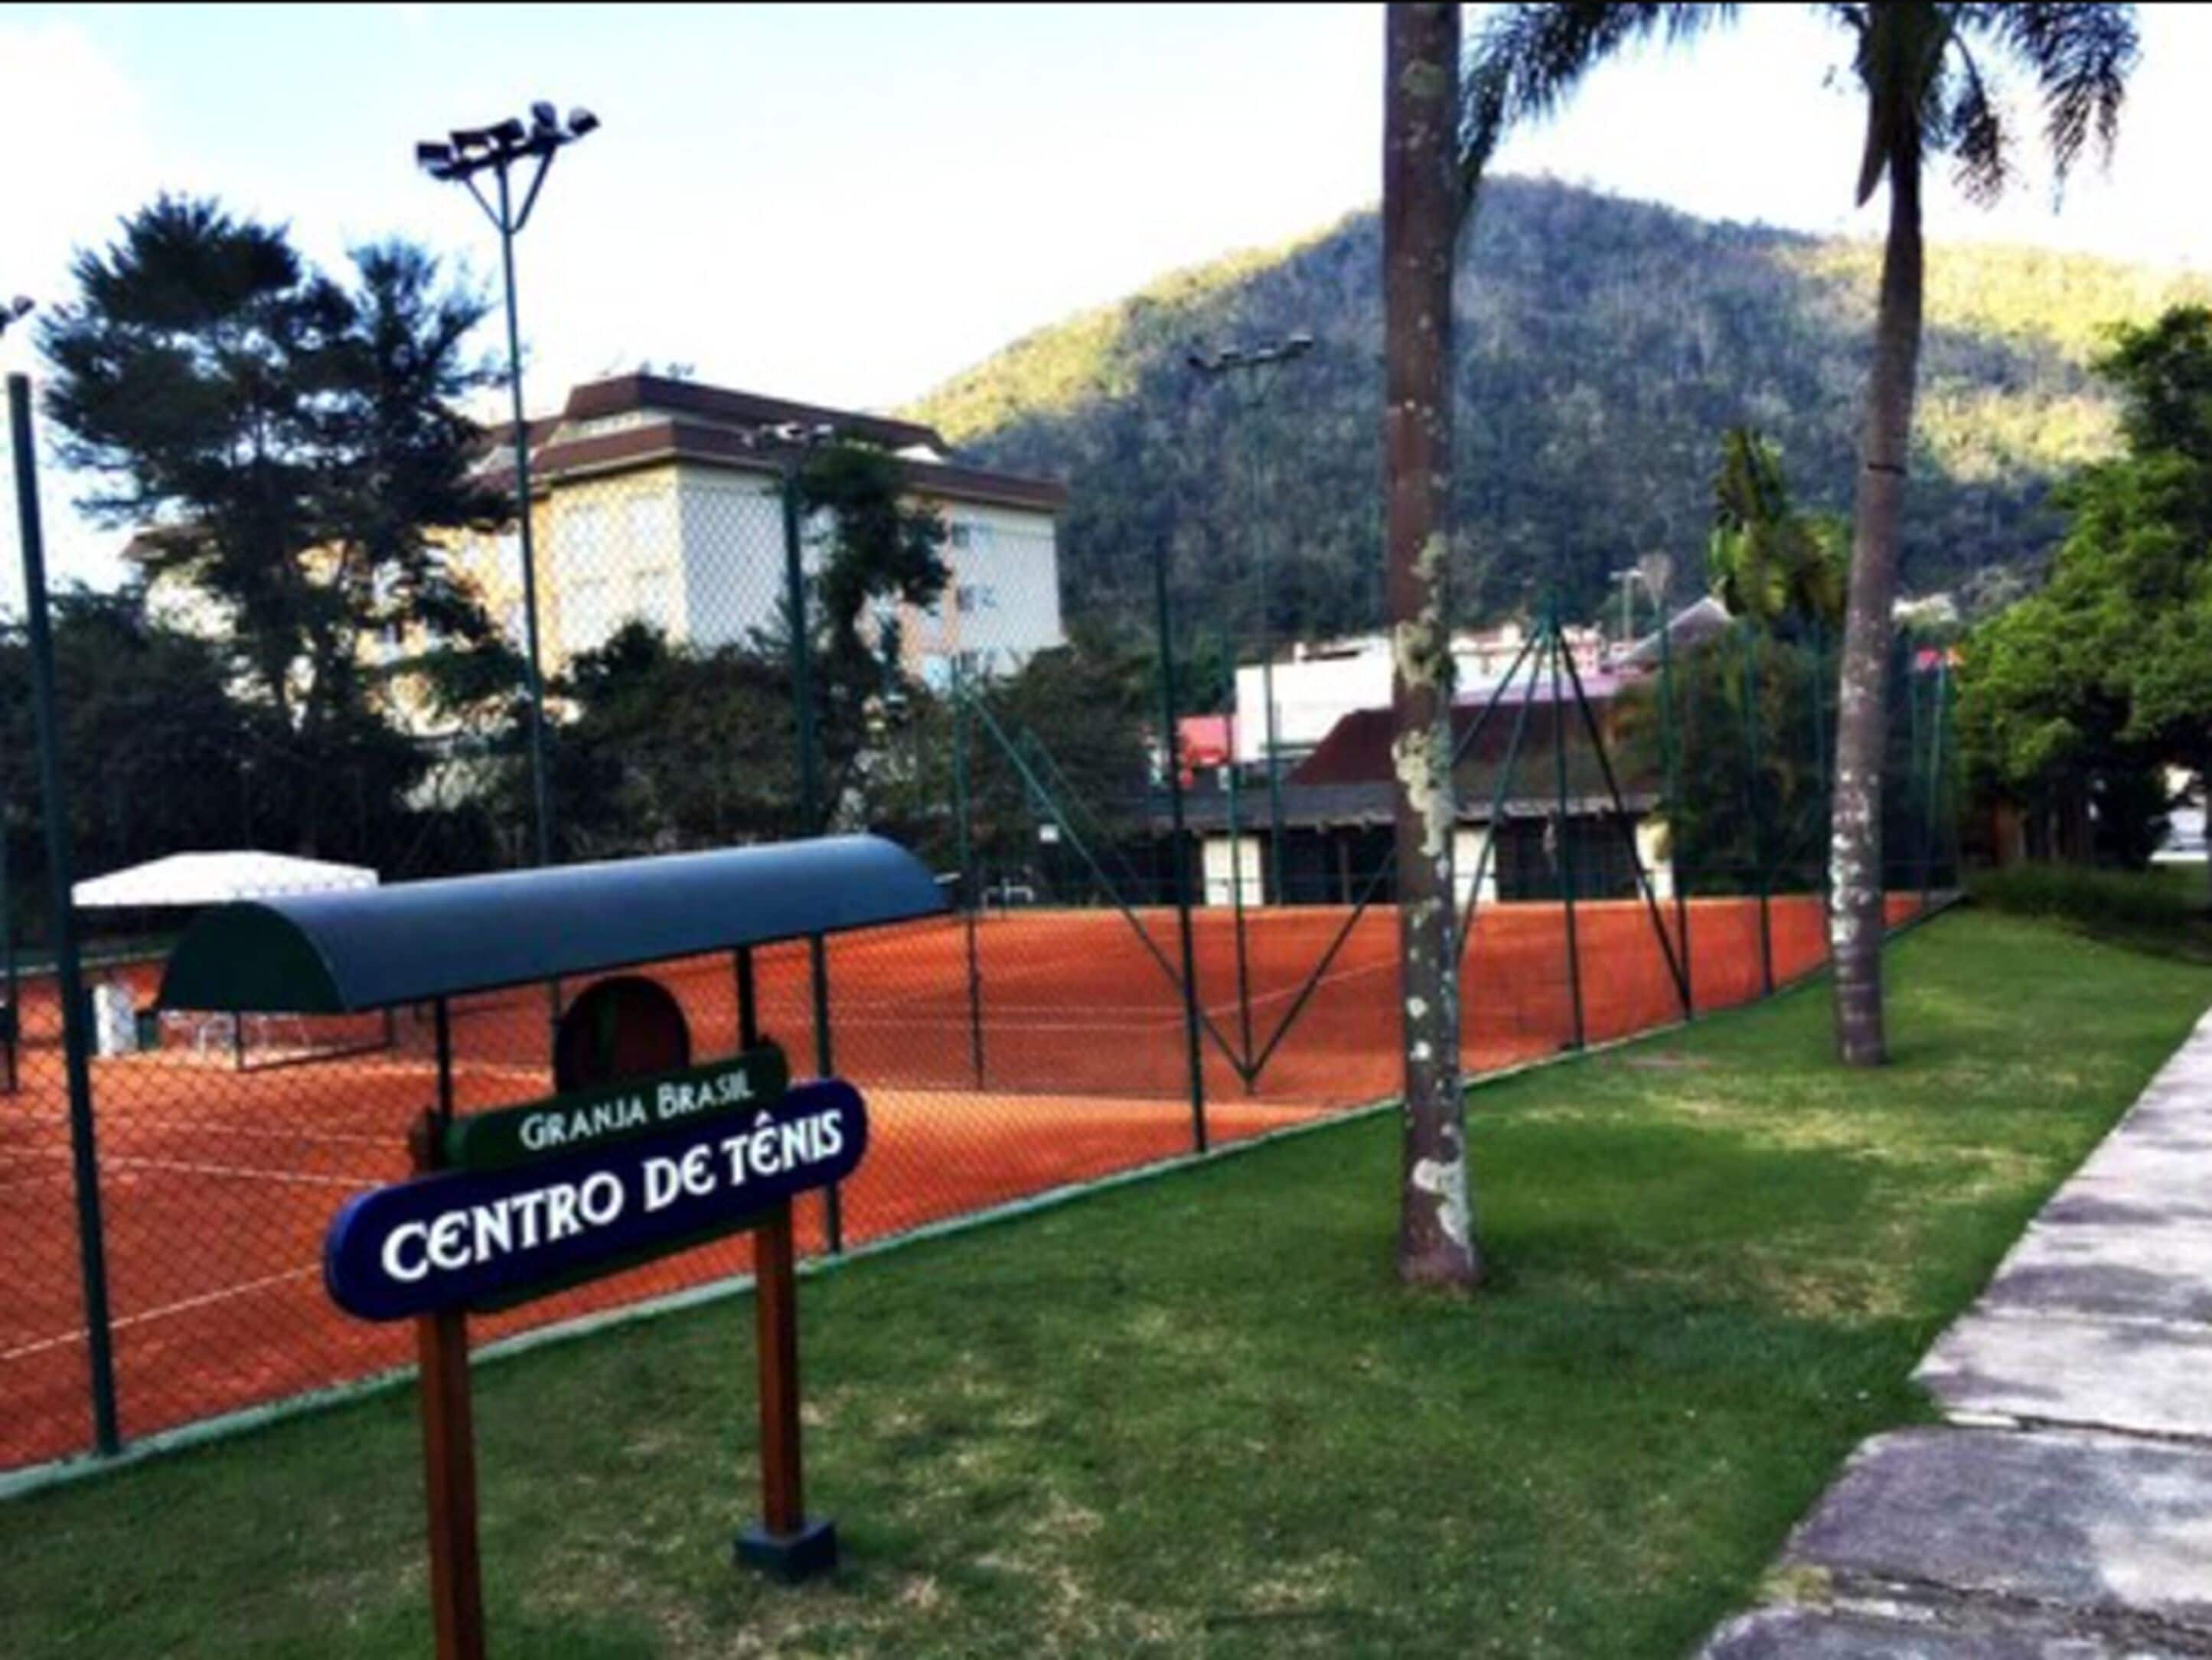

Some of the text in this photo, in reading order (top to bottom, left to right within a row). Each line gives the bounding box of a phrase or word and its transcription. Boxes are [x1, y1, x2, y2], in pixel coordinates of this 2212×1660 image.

[520, 1069, 756, 1150] GRANJA BRASIL
[381, 1109, 843, 1282] CENTRO DE TÊNIS
